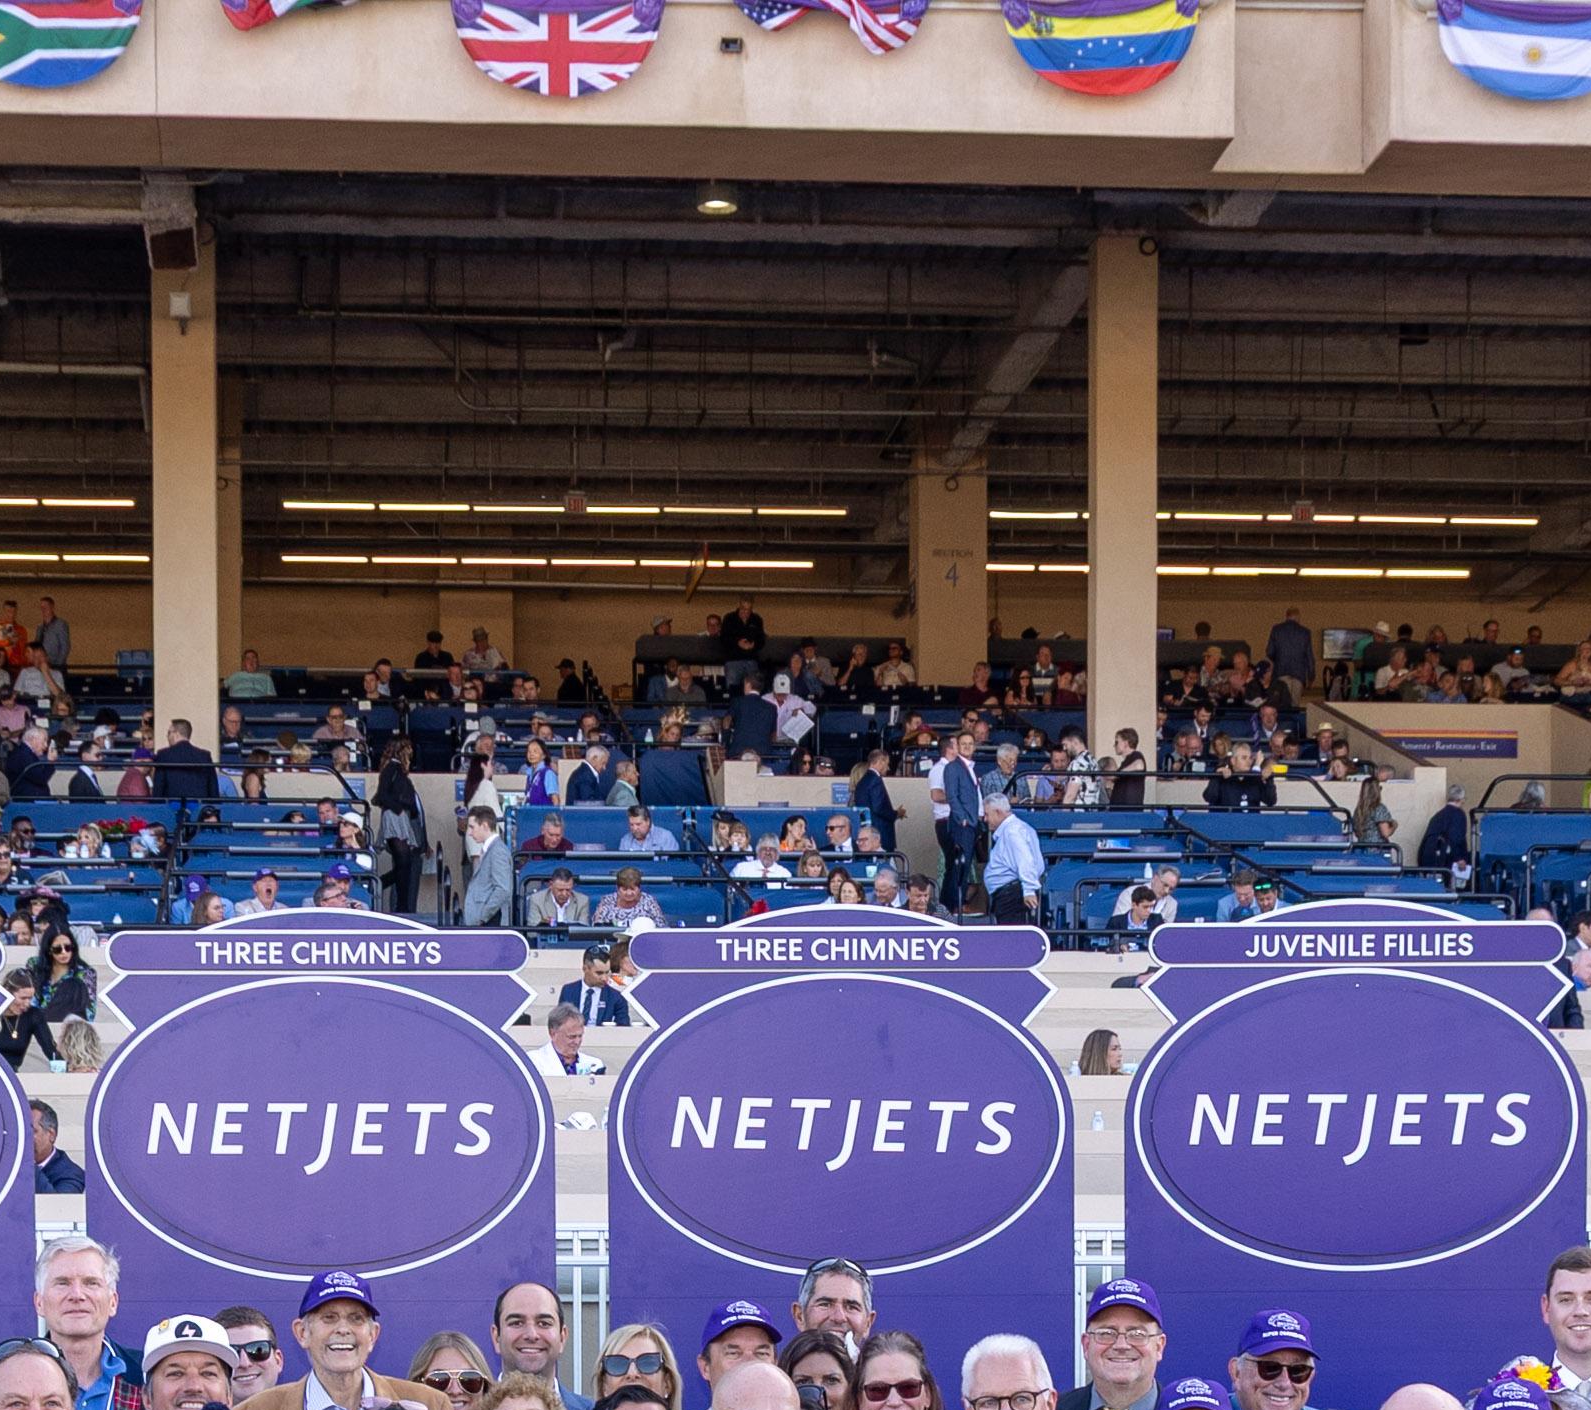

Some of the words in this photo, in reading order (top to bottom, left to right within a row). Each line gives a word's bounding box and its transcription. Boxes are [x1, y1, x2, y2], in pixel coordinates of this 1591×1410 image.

[945, 562, 960, 588] 4
[1480, 741, 1497, 750] Exit
[194, 941, 284, 965] THREE
[290, 941, 442, 966] CHIMNEYS
[715, 938, 803, 962] THREE
[810, 937, 960, 962] CHIMNEYS
[1245, 933, 1376, 958] JUVENILE
[1383, 933, 1474, 957] FILLIES
[147, 1102, 494, 1176] NETJETS
[670, 1096, 1016, 1172] NETJETS
[1189, 1092, 1531, 1166] NETJETS
